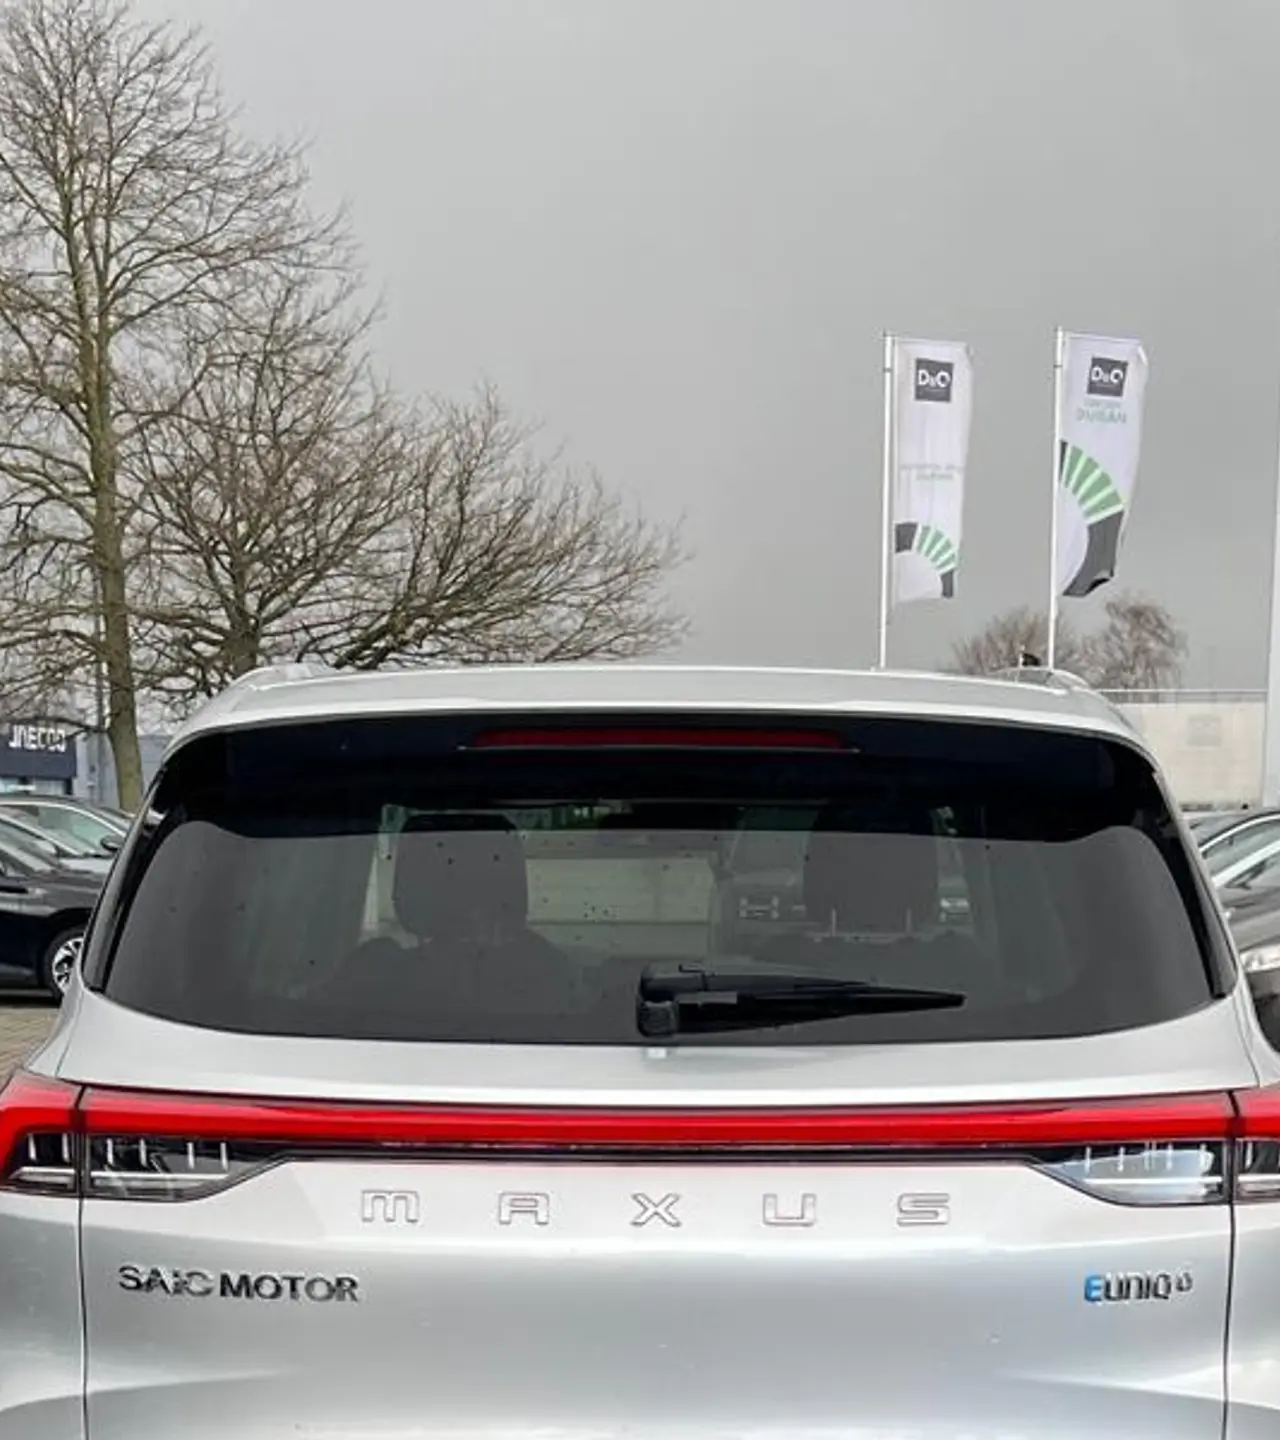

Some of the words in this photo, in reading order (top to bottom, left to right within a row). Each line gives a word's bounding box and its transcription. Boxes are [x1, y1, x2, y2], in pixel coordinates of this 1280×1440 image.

[361, 1189, 950, 1226] MAXUS
[118, 1265, 216, 1297] SAIC
[219, 1272, 361, 1302] MOTOR
